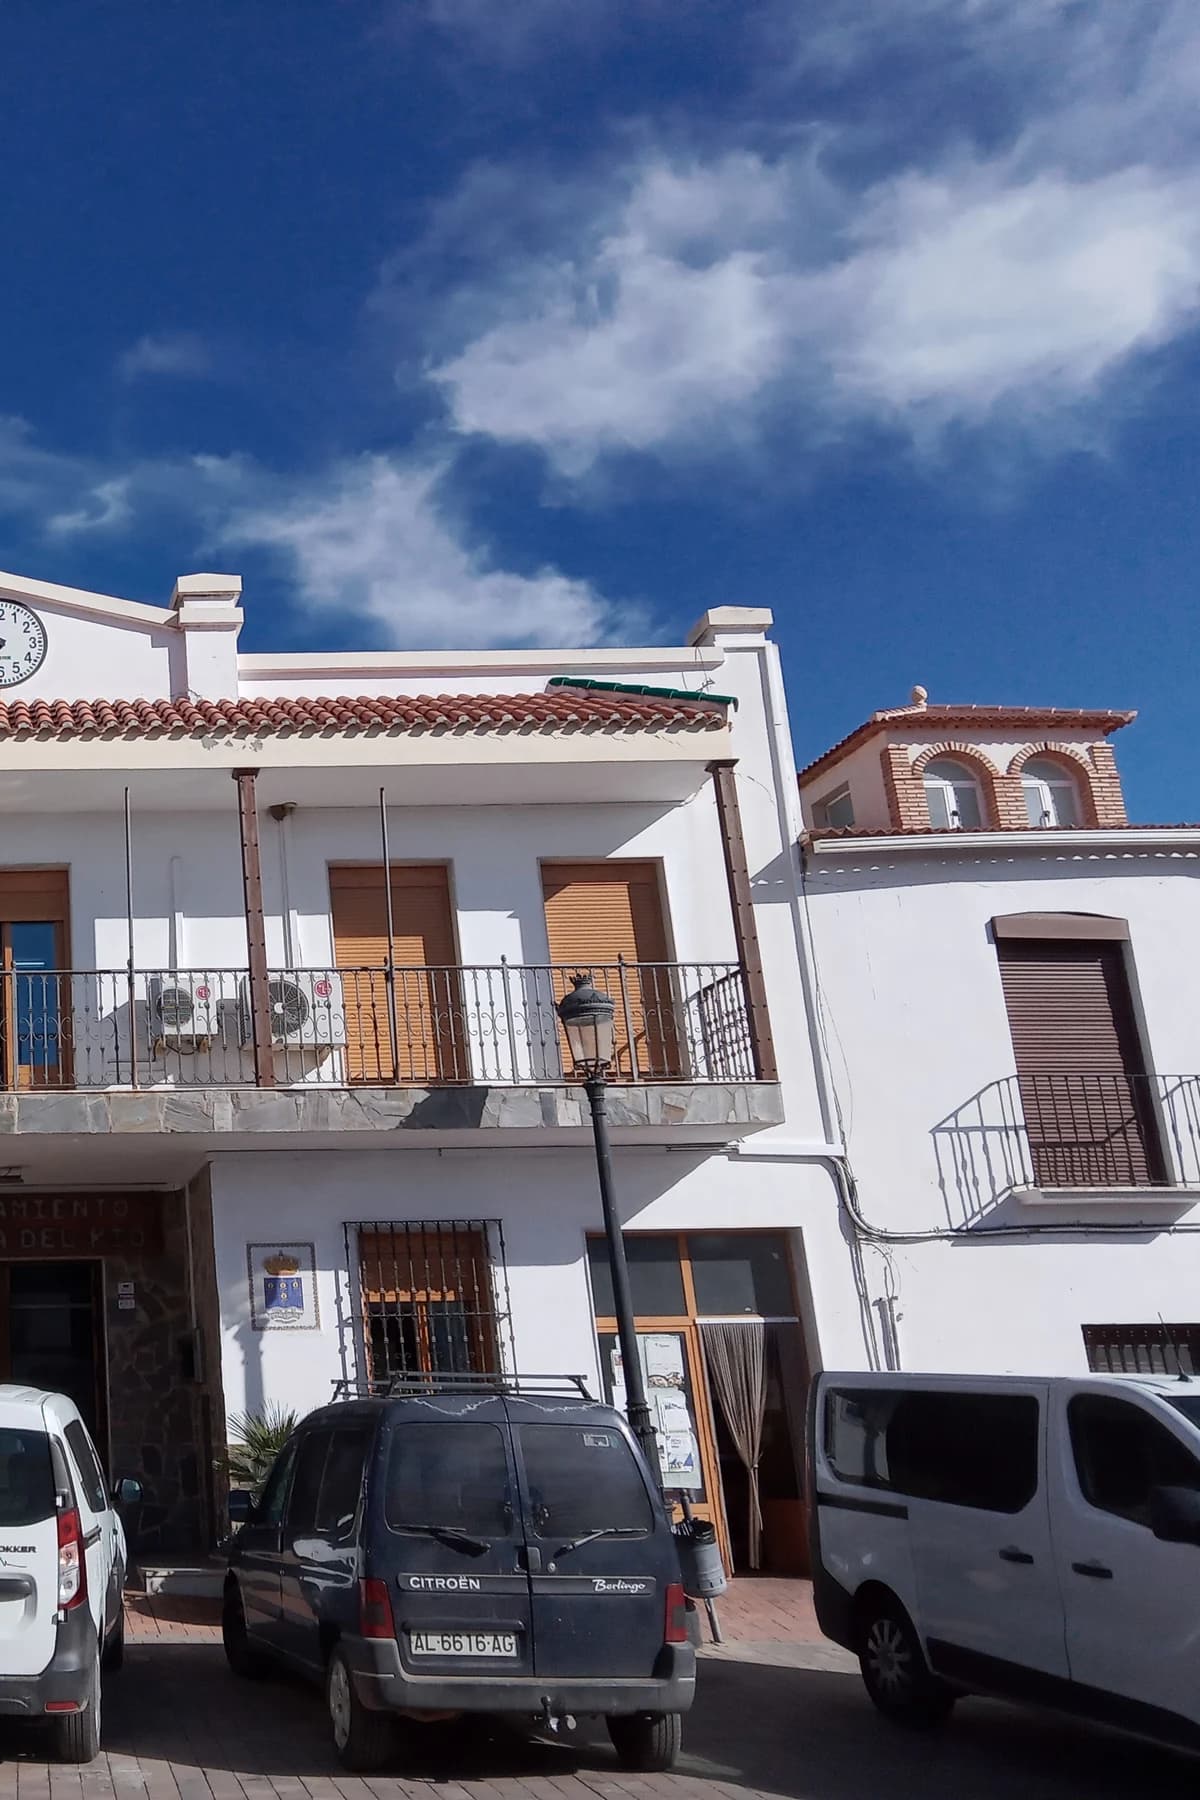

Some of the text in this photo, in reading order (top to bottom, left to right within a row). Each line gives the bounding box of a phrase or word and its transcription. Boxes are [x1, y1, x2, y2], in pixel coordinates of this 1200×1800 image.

[11, 612, 17, 624] 1
[23, 621, 31, 634] 2
[29, 637, 37, 649] 3
[24, 652, 32, 664] 4
[12, 662, 21, 674] 5
[21, 1227, 76, 1249] DEL
[409, 1575, 481, 1590] CITROËN
[592, 1579, 647, 1594] Berlingo
